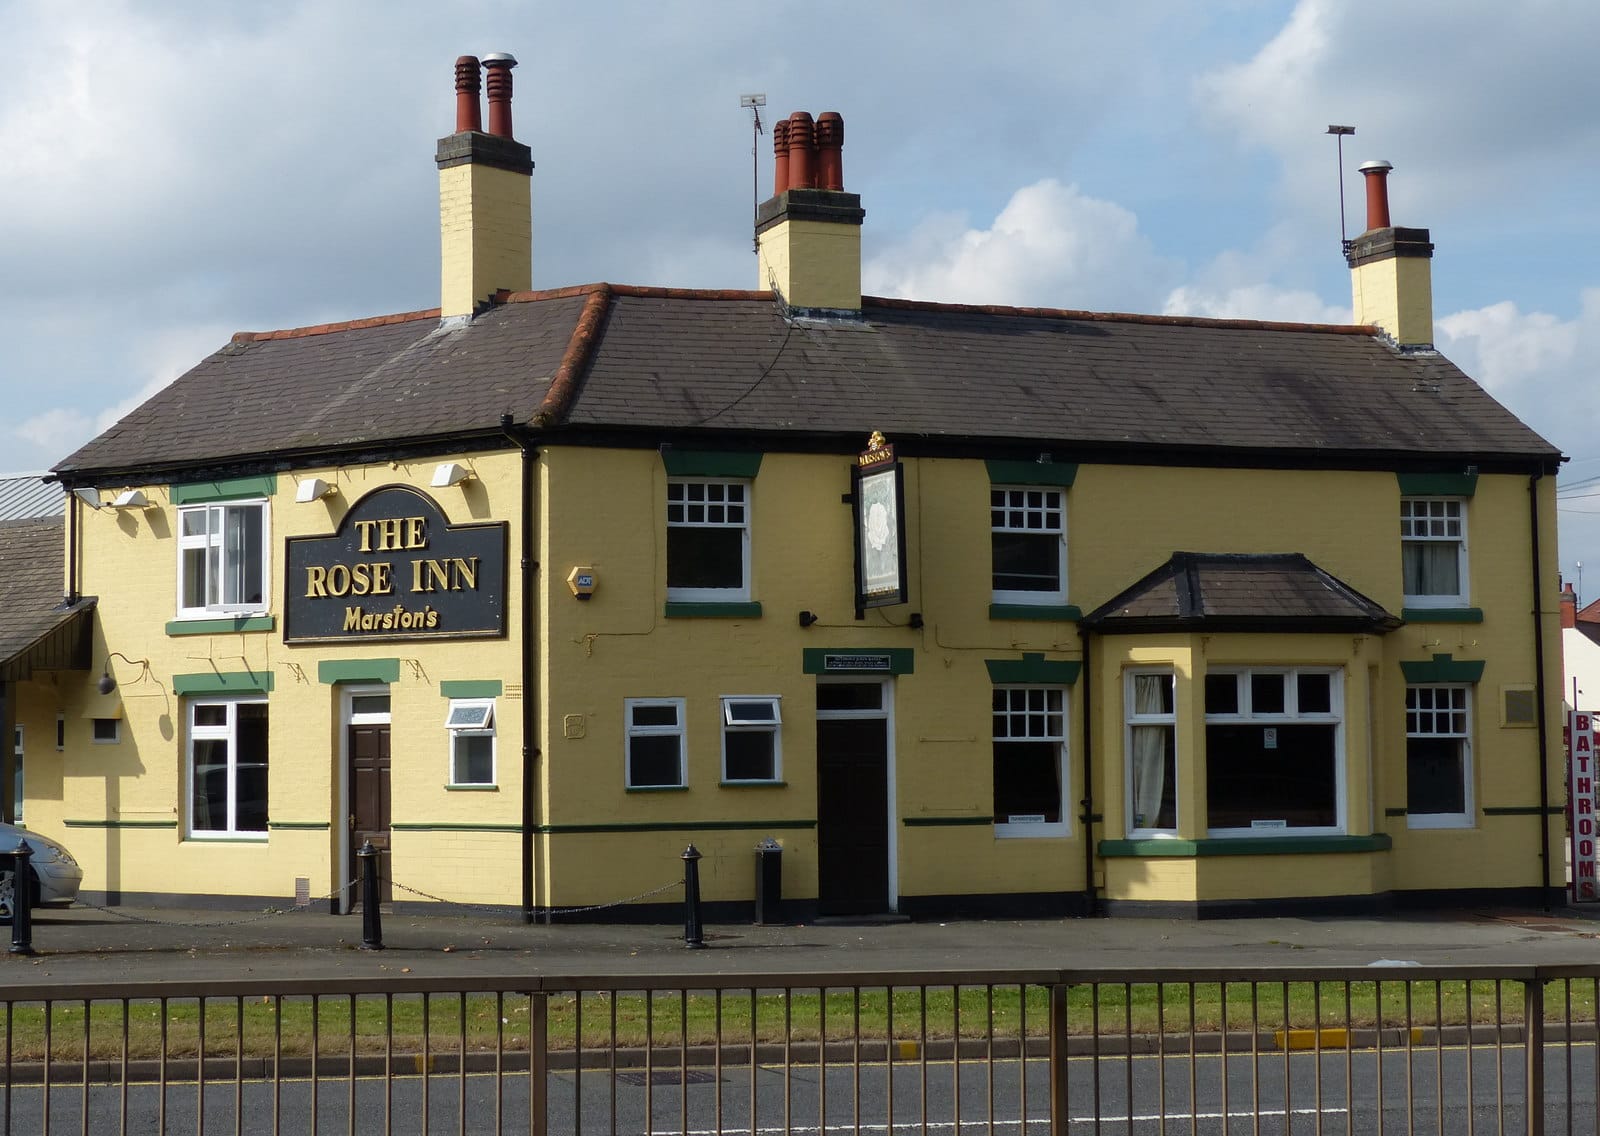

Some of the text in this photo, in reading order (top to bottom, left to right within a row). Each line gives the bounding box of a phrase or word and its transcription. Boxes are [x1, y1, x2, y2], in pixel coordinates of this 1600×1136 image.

[354, 516, 427, 552] THE
[304, 556, 479, 598] ROSE INN
[343, 604, 438, 631] Marston's
[1575, 715, 1594, 897] BATHROOMS
